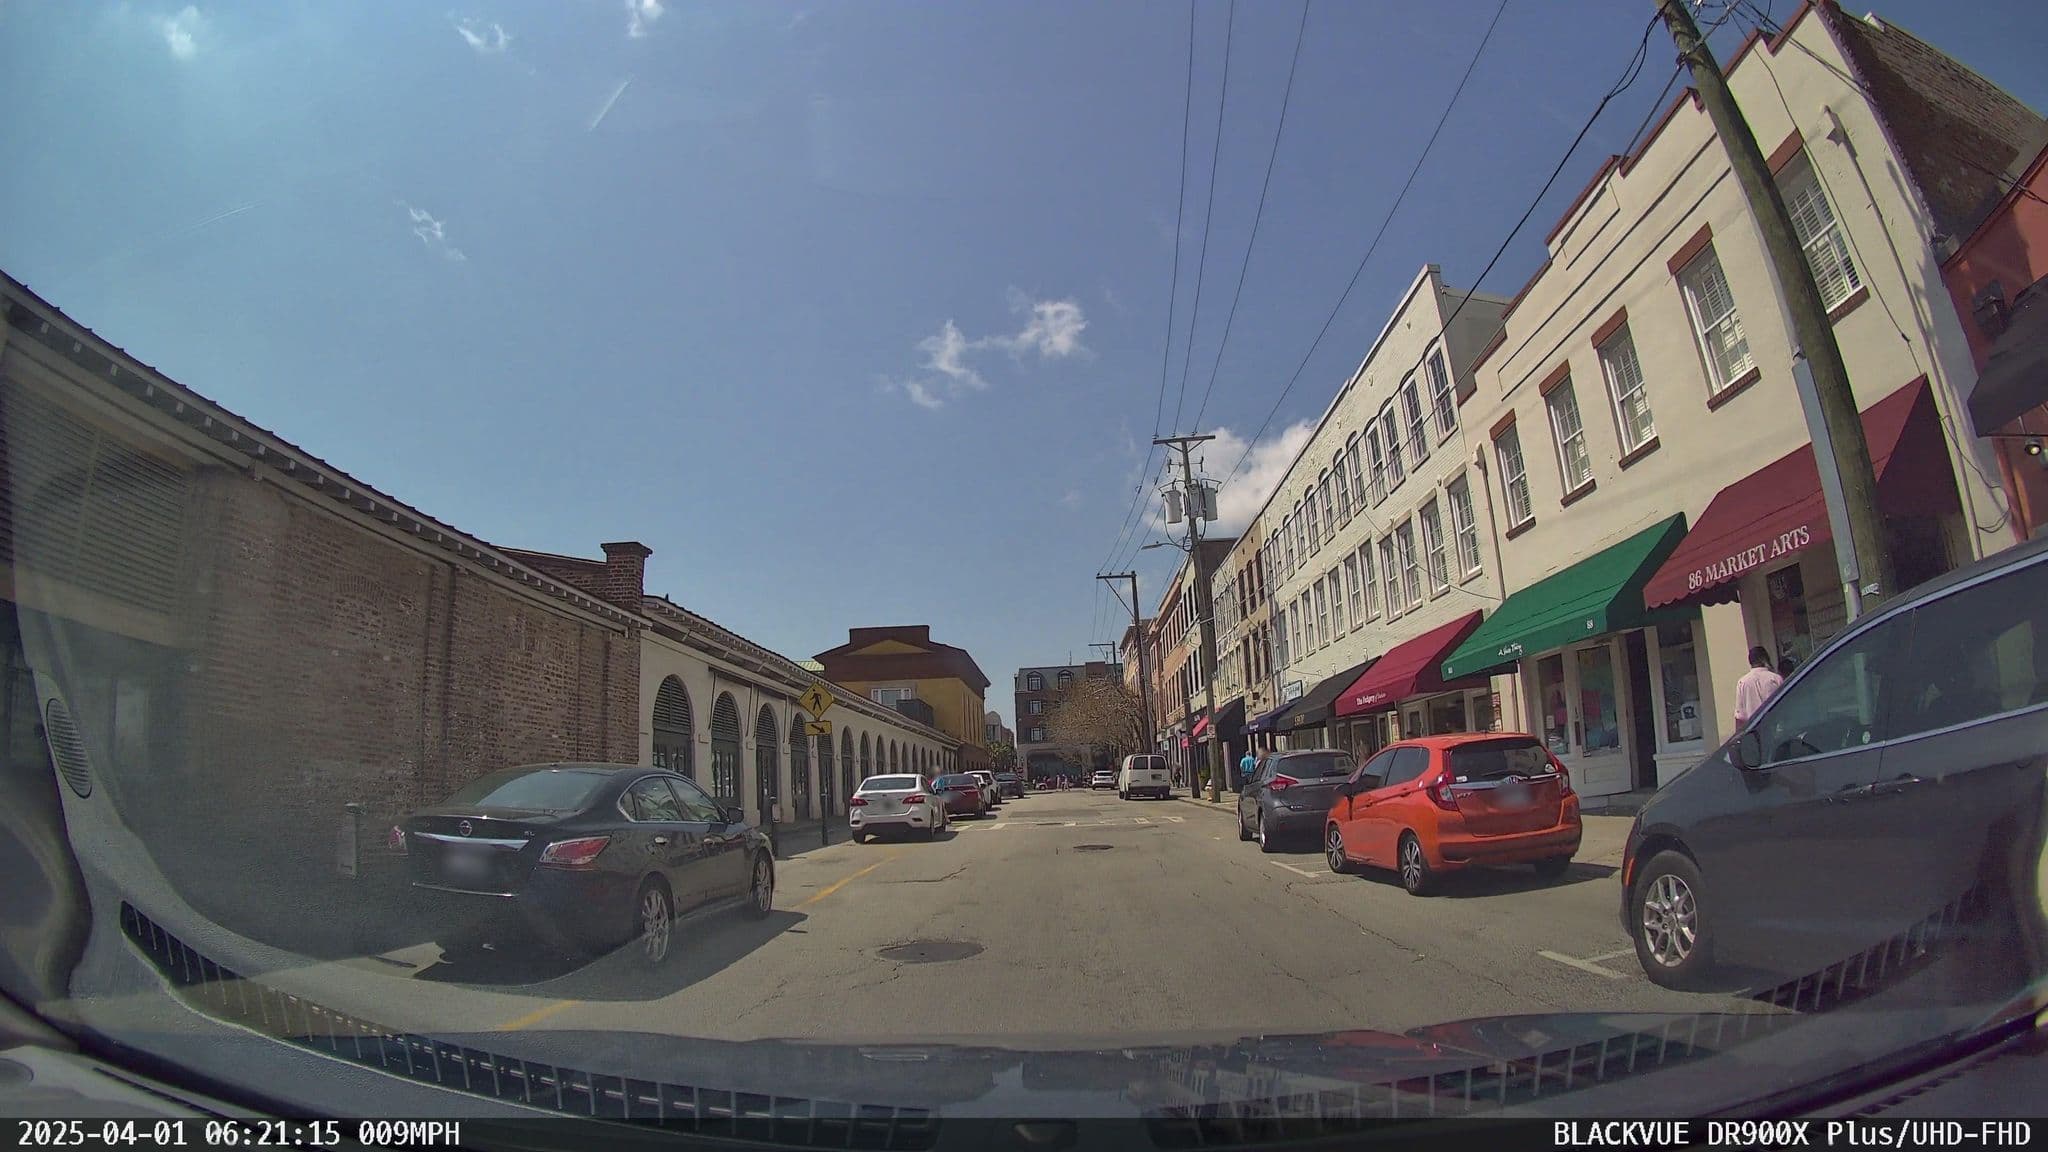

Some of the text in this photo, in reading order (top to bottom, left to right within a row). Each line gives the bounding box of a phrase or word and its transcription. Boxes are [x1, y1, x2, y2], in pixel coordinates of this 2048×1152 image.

[1688, 525, 1810, 590] 86 MARKET ARTS
